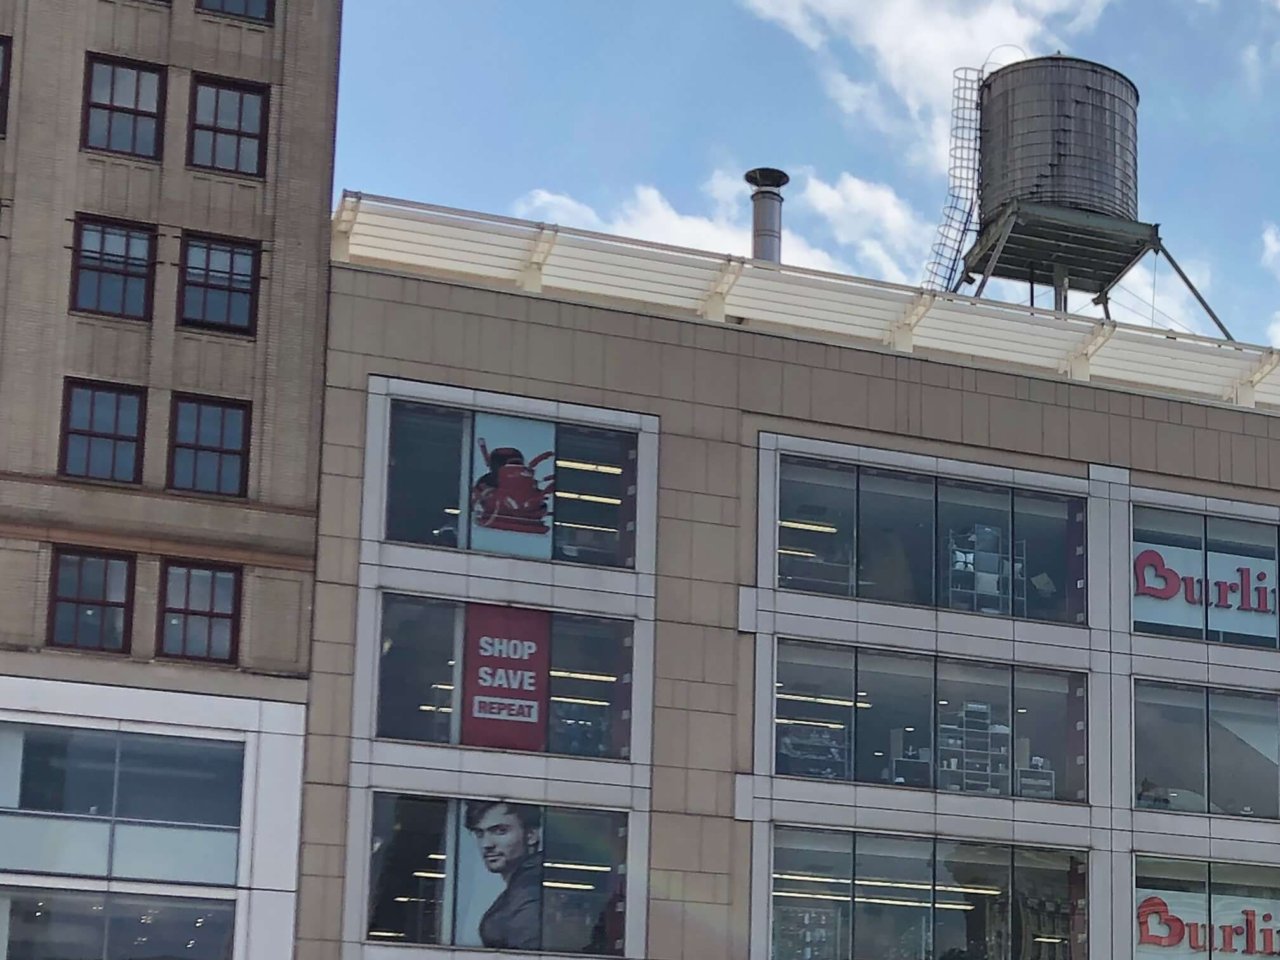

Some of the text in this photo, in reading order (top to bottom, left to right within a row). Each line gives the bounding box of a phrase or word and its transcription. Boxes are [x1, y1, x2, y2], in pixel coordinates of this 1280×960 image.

[479, 635, 537, 660] SHOP
[478, 666, 537, 691] SAVE
[477, 700, 534, 718] REPEAT
